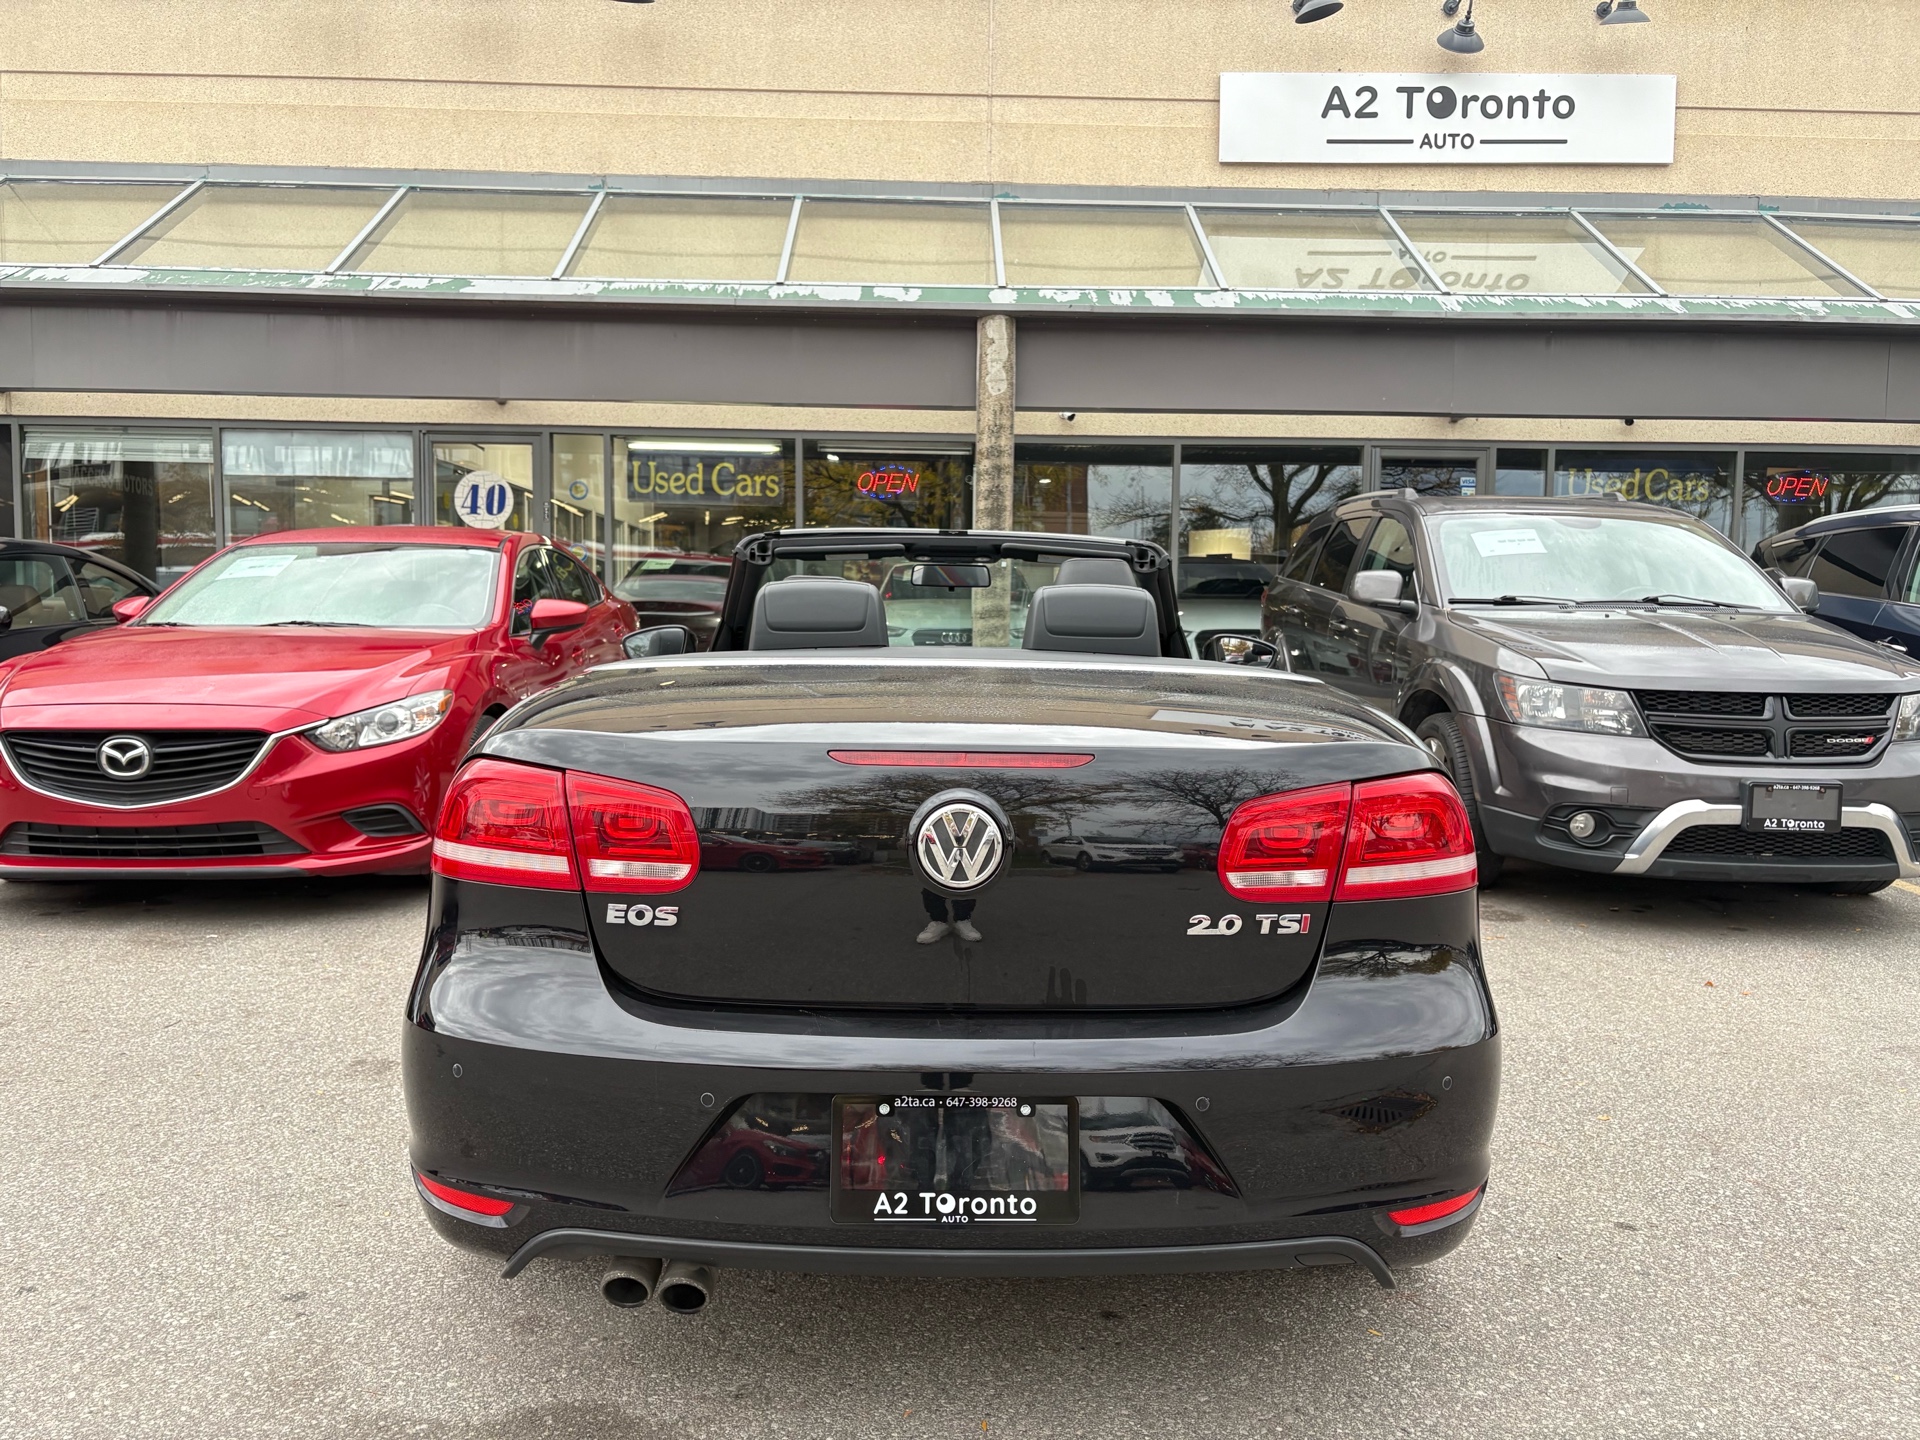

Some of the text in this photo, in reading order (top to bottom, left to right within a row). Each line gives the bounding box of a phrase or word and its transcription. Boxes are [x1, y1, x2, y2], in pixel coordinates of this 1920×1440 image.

[1321, 85, 1379, 119] A2
[1419, 133, 1475, 149] AUTO
[631, 461, 780, 498] Used Cars
[857, 471, 919, 493] OPEN
[1568, 468, 1709, 501] Used Cars
[1766, 475, 1828, 498] OPEN
[461, 484, 506, 516] 40
[1764, 818, 1777, 828] A2
[606, 903, 679, 927] EOS
[1255, 913, 1311, 935] TSI
[894, 1096, 1018, 1108] a2ta.ca 647-398-9268
[874, 1192, 908, 1215] A2
